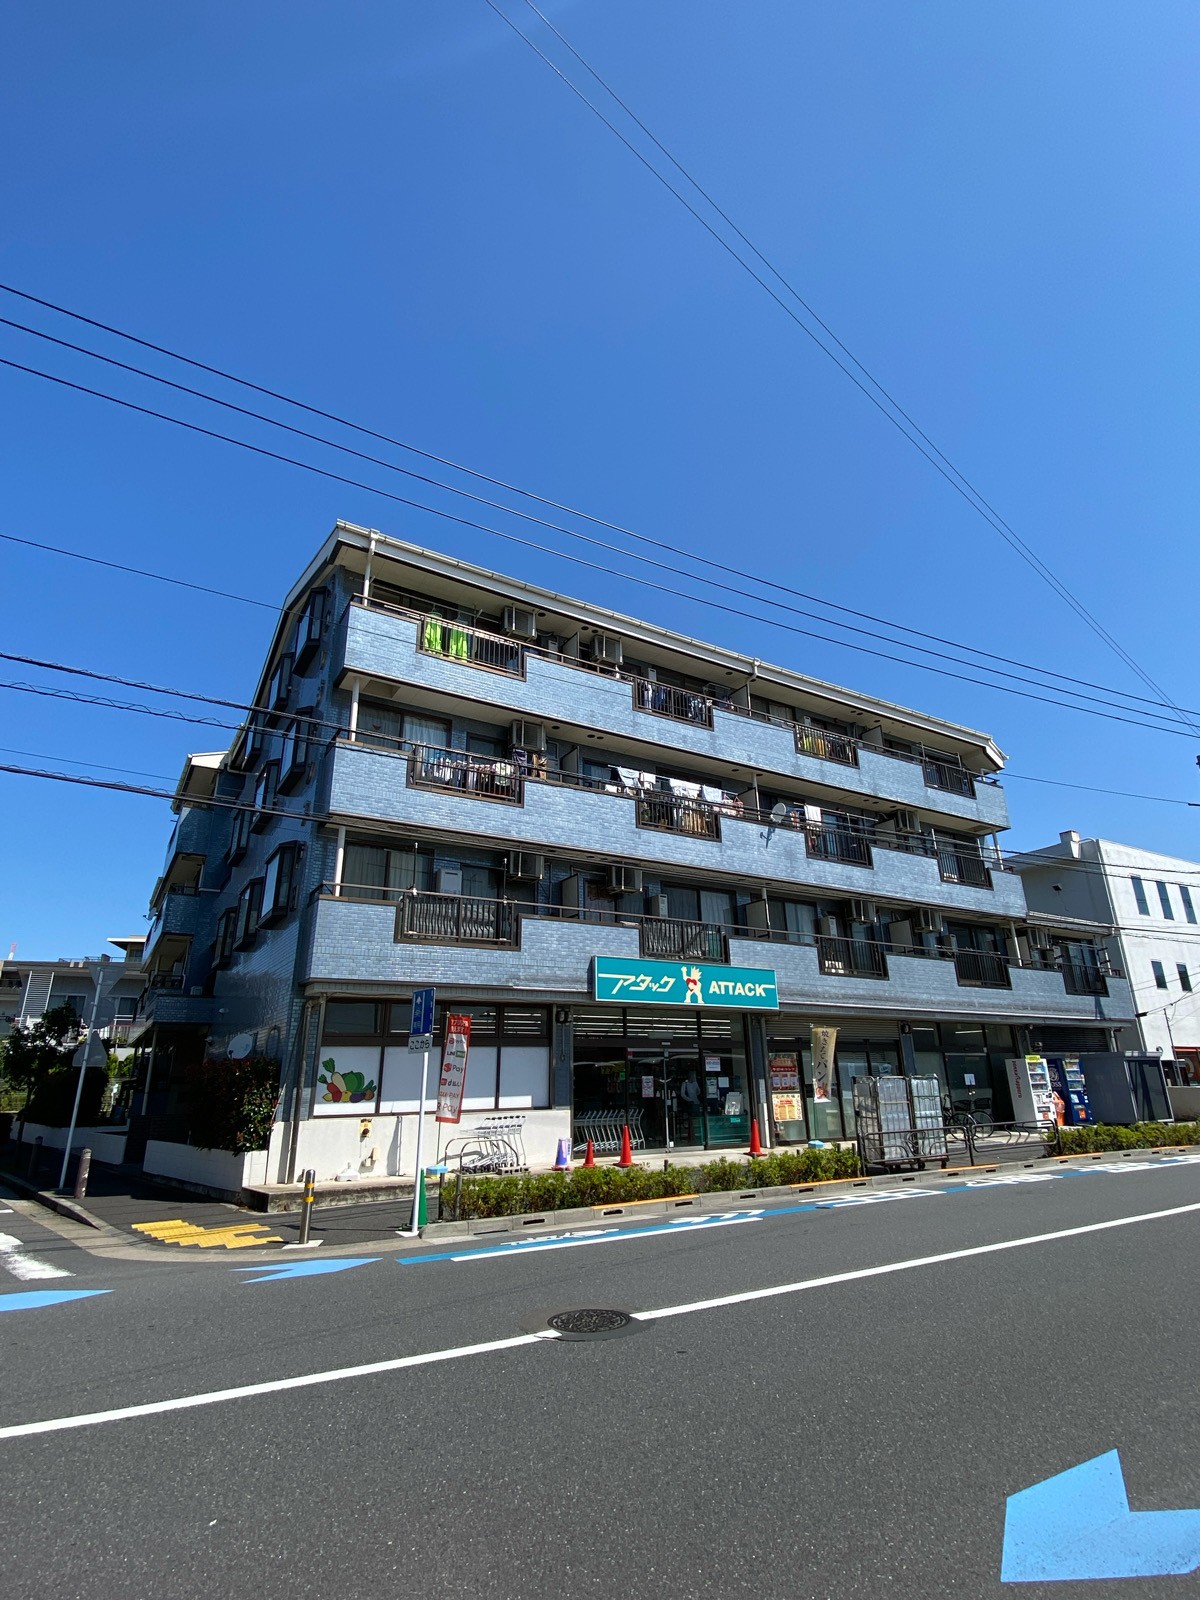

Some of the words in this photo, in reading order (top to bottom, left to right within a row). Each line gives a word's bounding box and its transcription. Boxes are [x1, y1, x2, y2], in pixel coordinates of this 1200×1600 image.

[598, 973, 676, 995] アタック
[709, 980, 775, 997] ATTACK
[409, 1039, 430, 1050] ここから
[816, 1030, 829, 1082] 焼きたてパン
[452, 1064, 464, 1073] Pay
[442, 1103, 458, 1114] Pay
